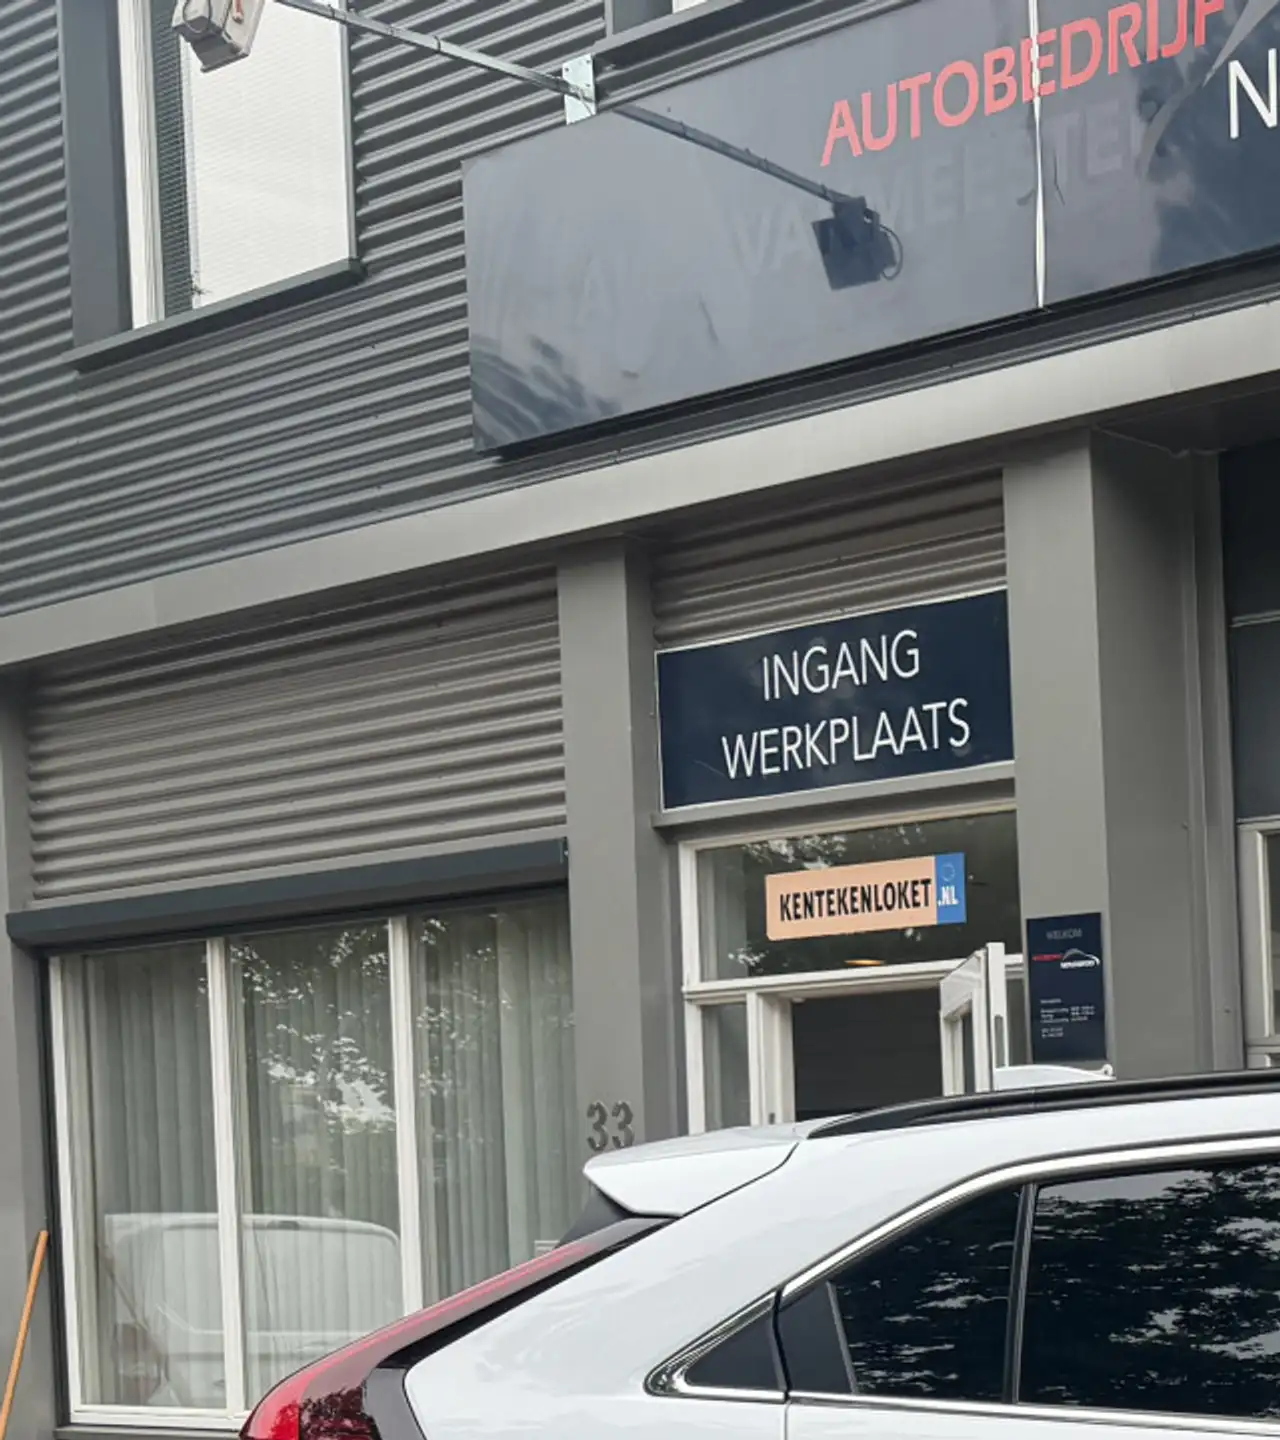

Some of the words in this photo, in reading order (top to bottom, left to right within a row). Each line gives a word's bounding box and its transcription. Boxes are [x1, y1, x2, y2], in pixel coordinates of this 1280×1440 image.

[815, 0, 1225, 168] AUTOBEDRIJF
[762, 629, 920, 700] INGANG
[721, 697, 971, 779] WERKPLAATS
[586, 1102, 634, 1152] 33
